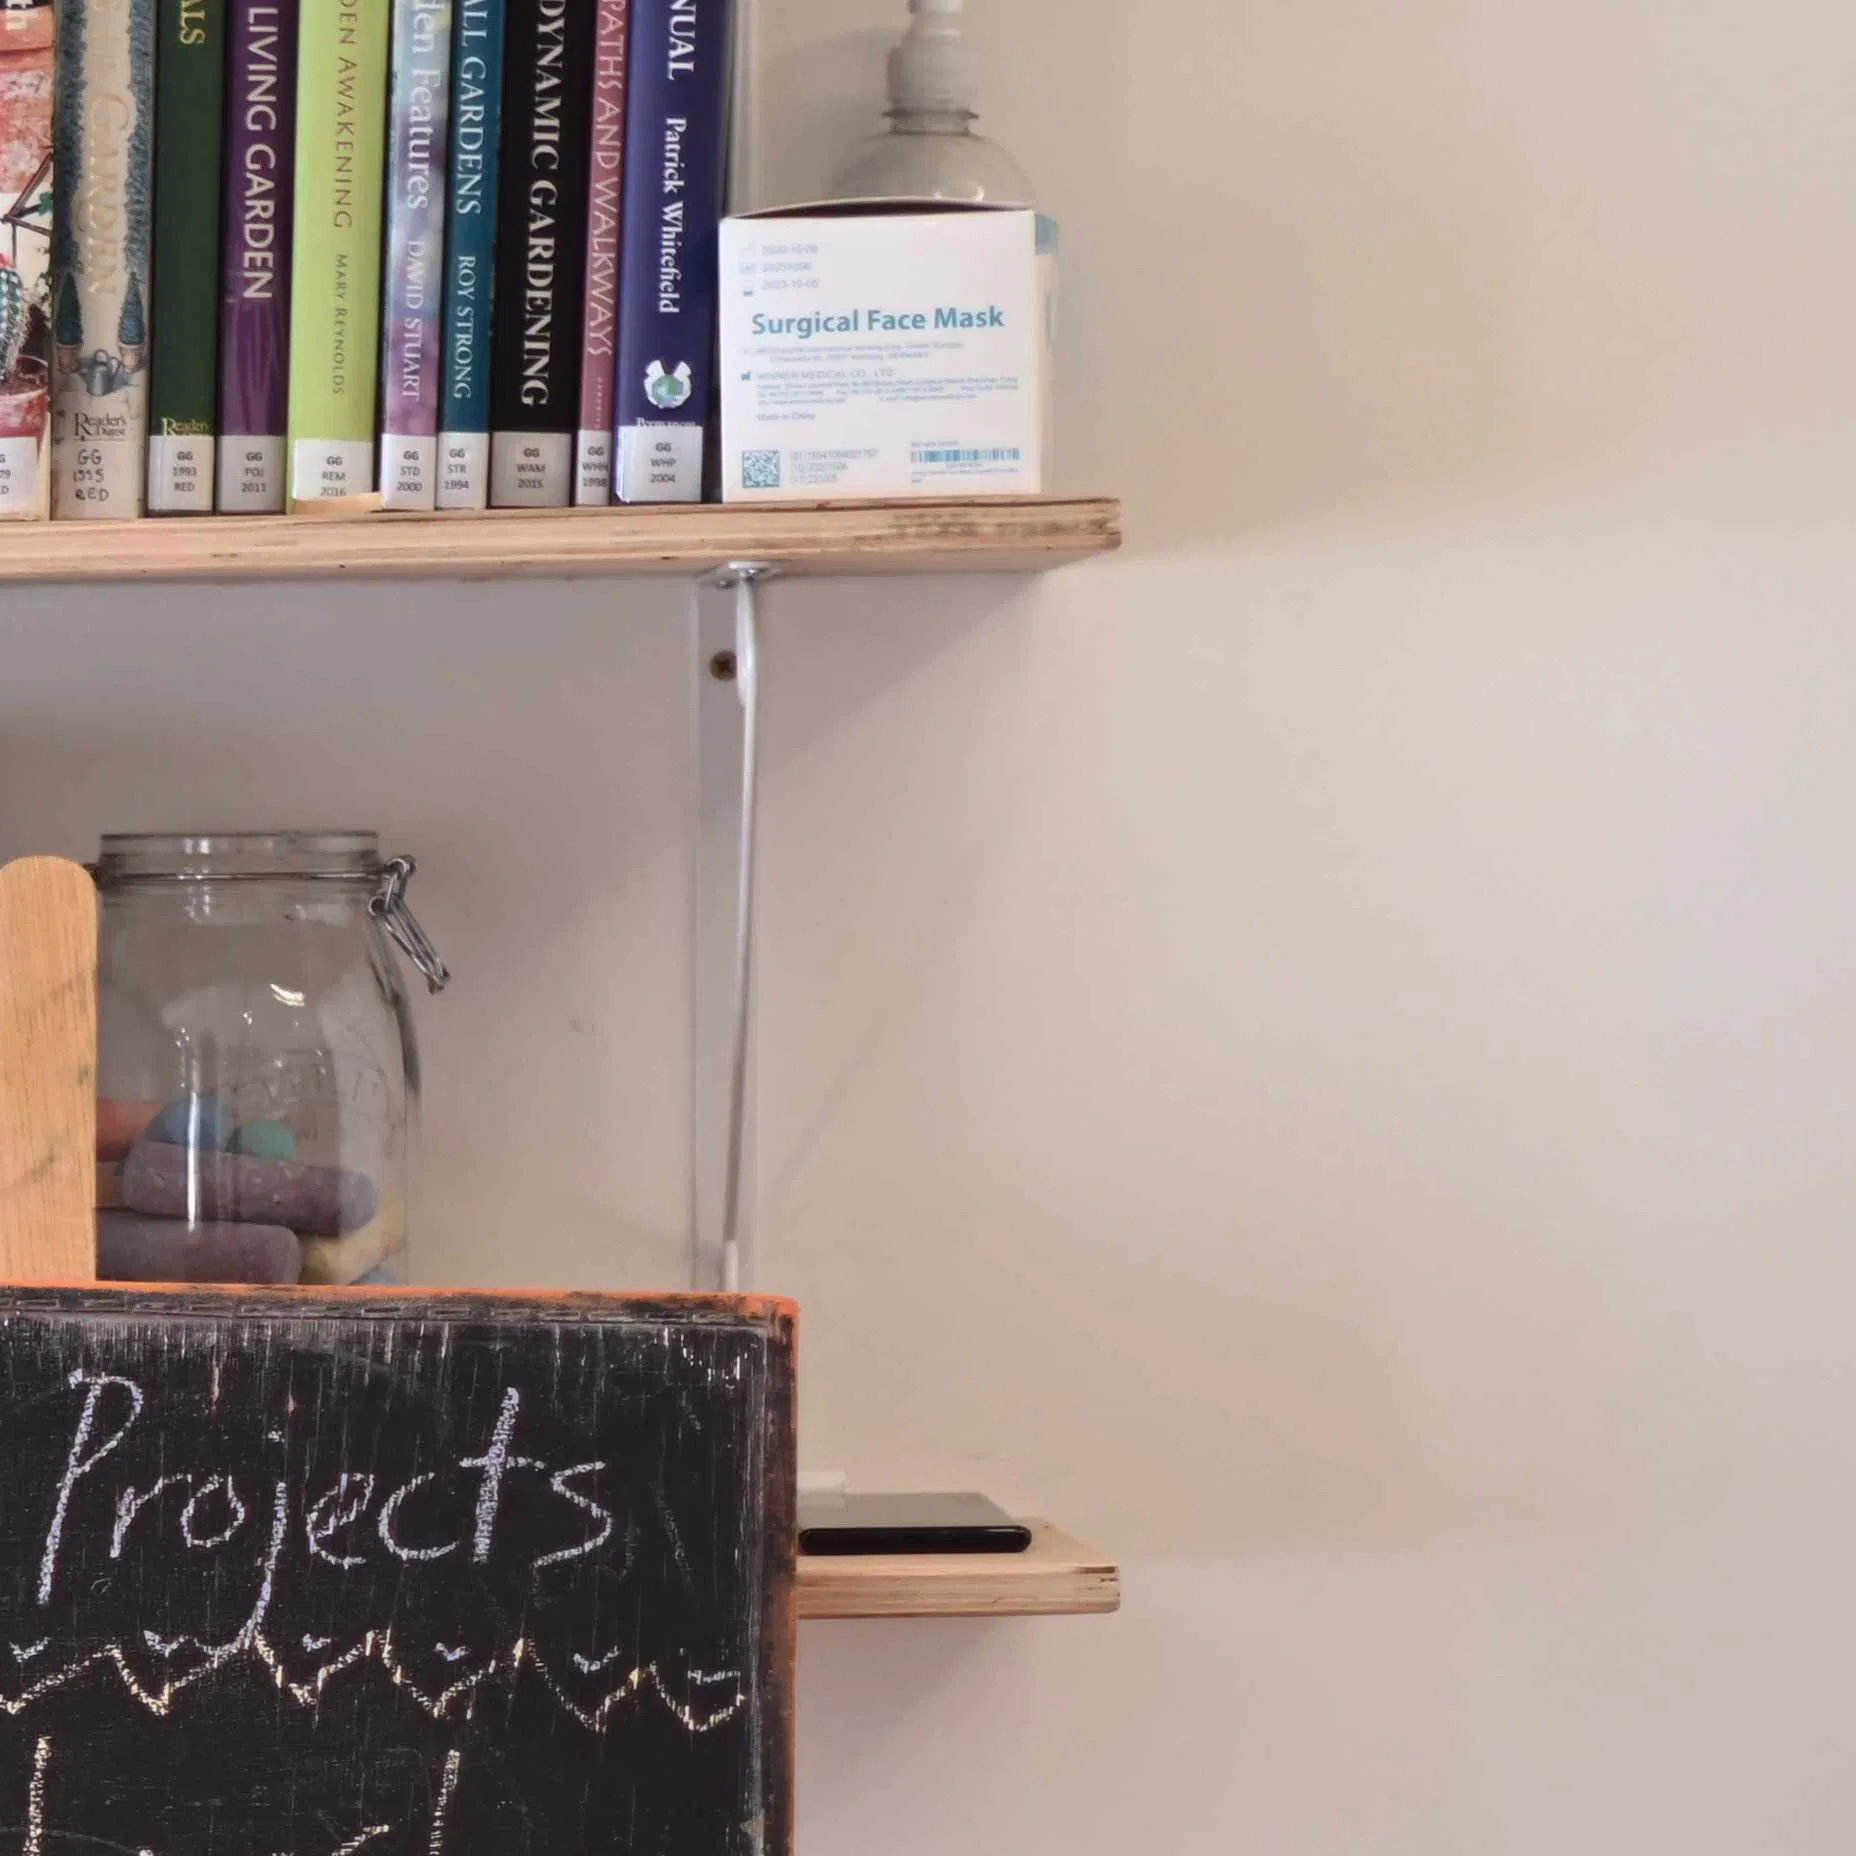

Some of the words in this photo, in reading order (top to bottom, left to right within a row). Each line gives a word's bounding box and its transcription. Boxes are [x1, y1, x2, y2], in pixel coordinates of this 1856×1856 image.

[247, 7, 279, 132] LIVING
[334, 56, 359, 229] AWAKENING
[407, 68, 441, 210] Features
[456, 56, 487, 217] GARDENS
[243, 143, 277, 299] GARDEN
[663, 116, 687, 195] Patrick
[520, 178, 558, 407] GARDENING
[658, 201, 685, 314] Whitefield
[751, 309, 859, 339] Surgical
[867, 308, 927, 332] Face
[934, 305, 1005, 329] Mask
[34, 1368, 616, 1656] Projects
